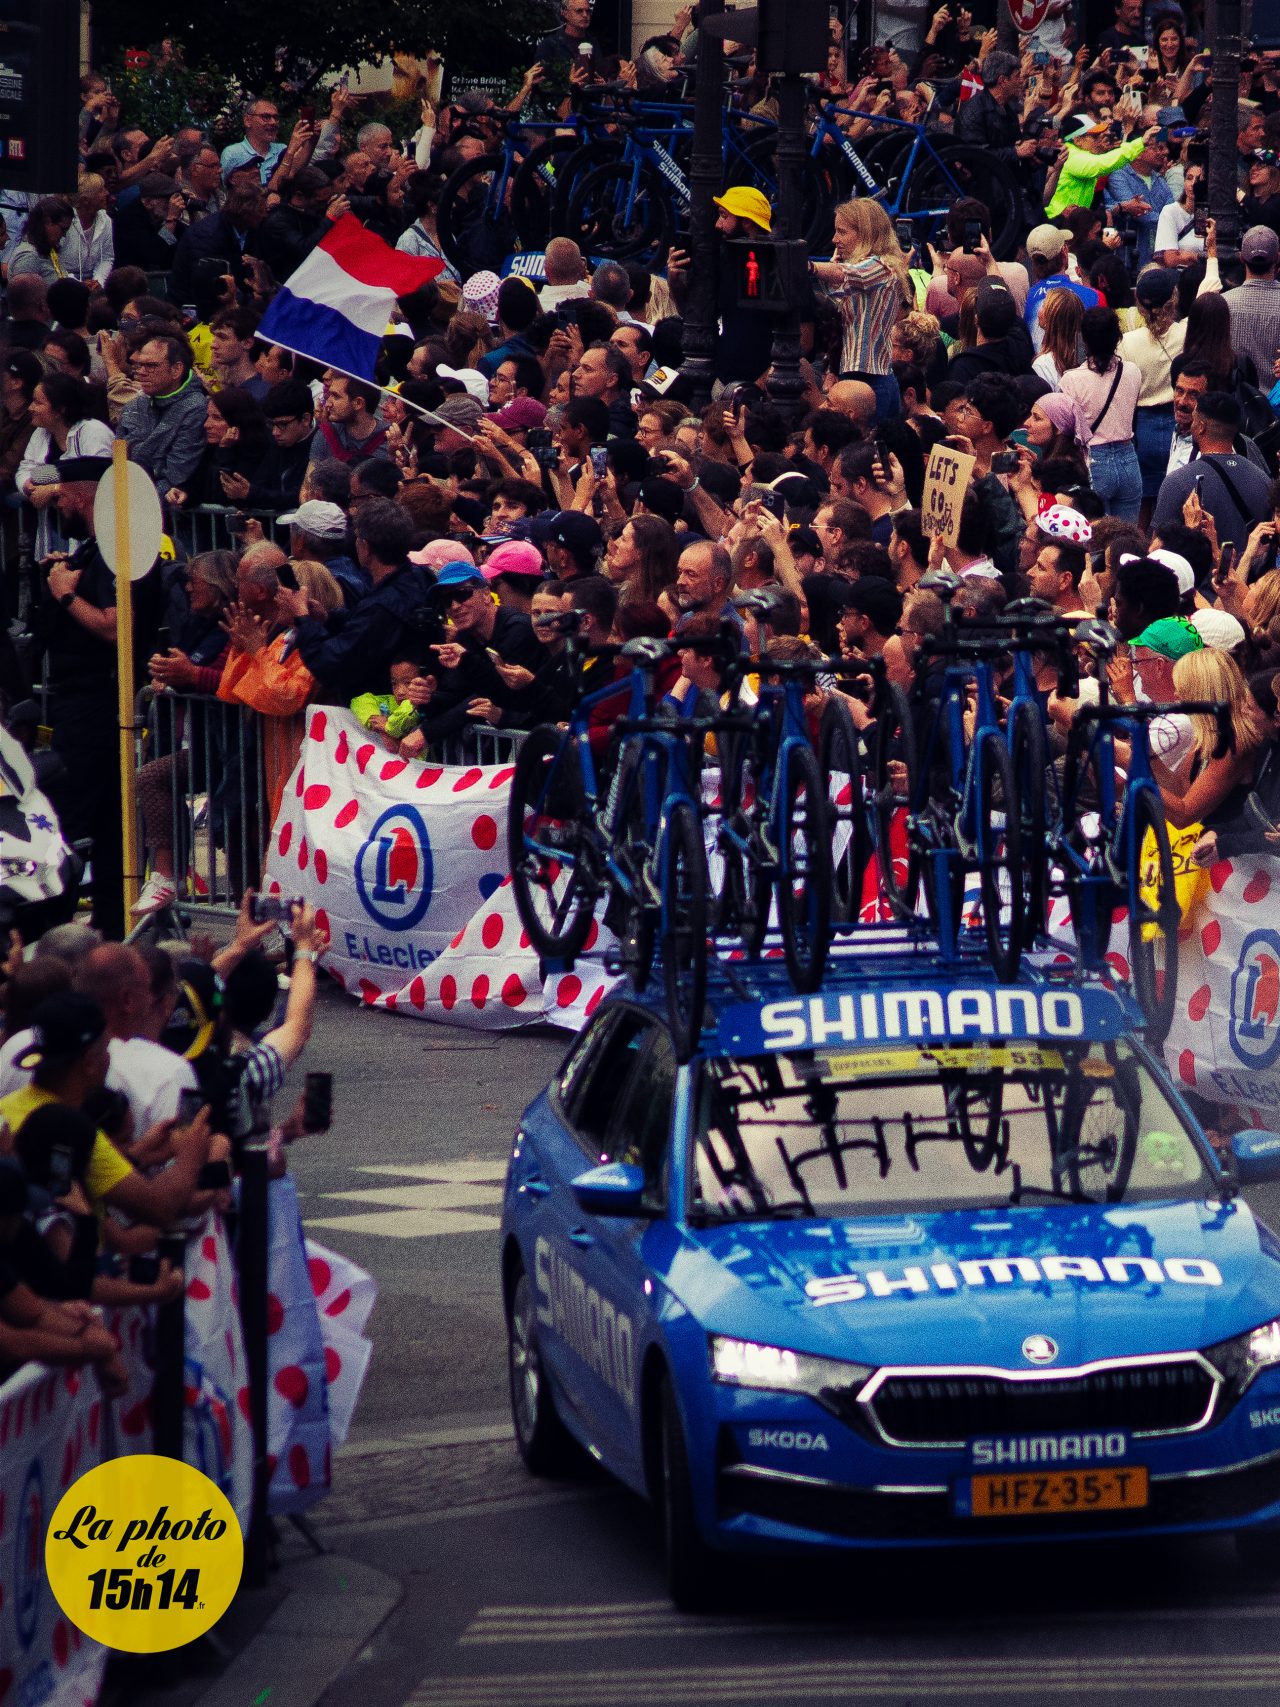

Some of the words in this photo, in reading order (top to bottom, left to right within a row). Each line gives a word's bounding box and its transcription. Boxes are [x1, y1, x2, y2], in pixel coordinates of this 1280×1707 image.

[841, 140, 877, 189] SHIMANO
[928, 455, 959, 486] LET'S
[930, 488, 945, 514] GO
[759, 989, 1084, 1051] SHIMANO
[1010, 1051, 1046, 1067] 53
[804, 1256, 1223, 1308] SHIMANO
[535, 1235, 636, 1406] SHIMANO
[972, 1433, 1127, 1466] SHIMANO
